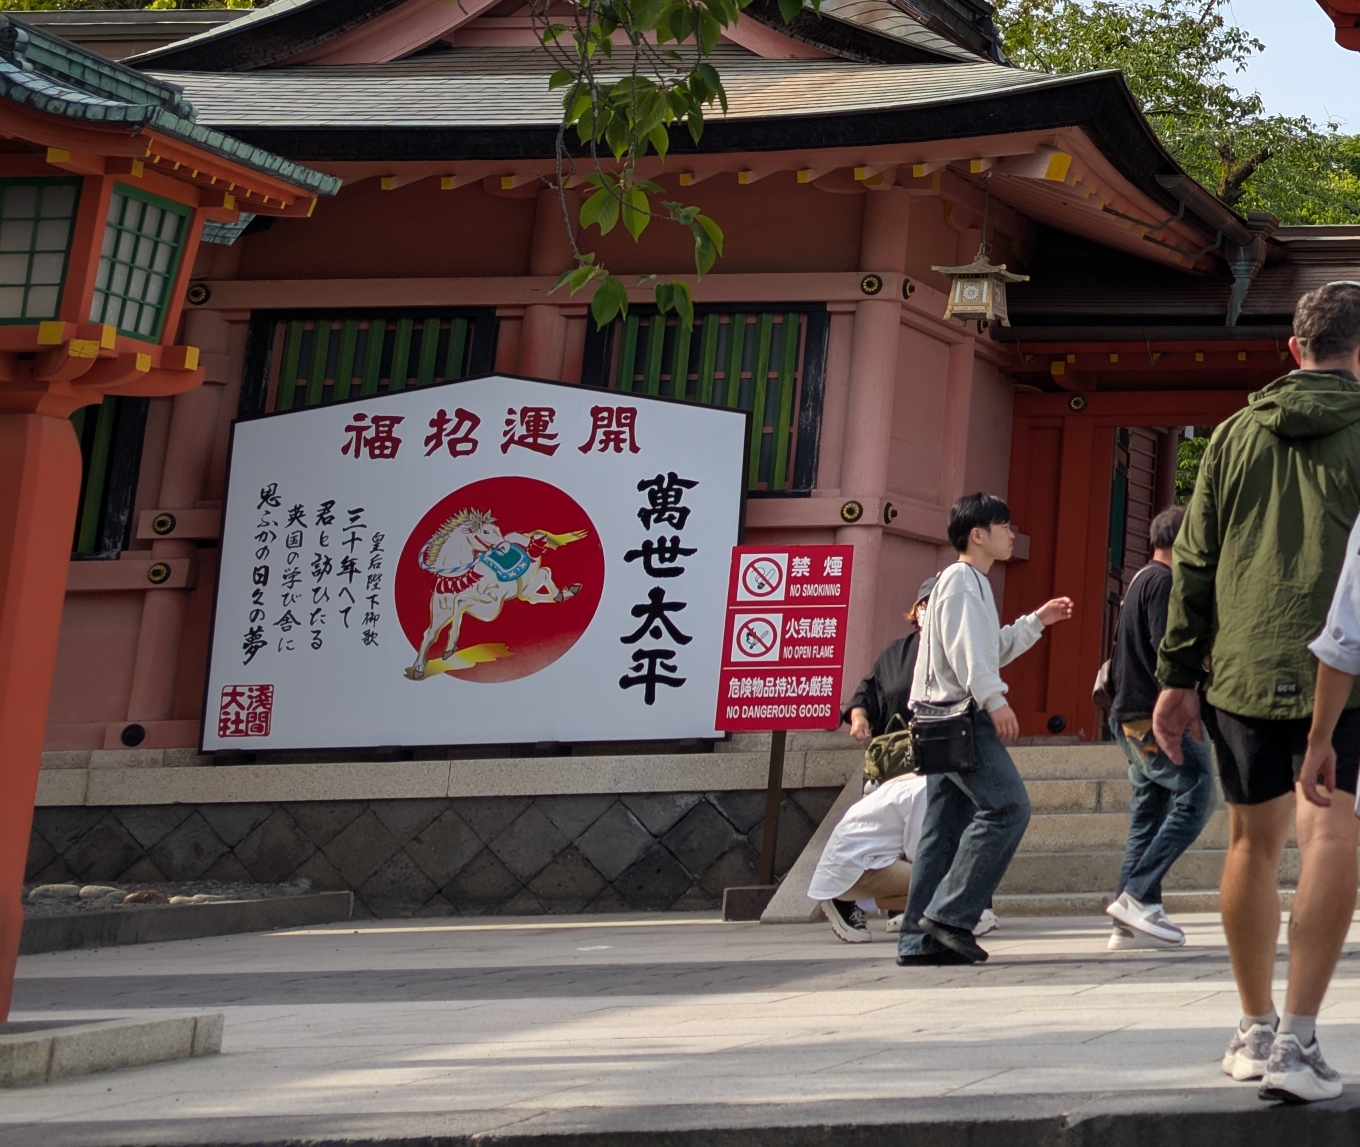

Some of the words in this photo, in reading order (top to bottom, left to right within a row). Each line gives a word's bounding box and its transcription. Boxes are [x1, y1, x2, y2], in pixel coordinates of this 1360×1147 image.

[242, 482, 282, 666] 思ふかの日々の夢
[272, 504, 308, 652] 英国の学び舎に
[310, 500, 336, 650] 君と訪ひたる
[336, 507, 367, 629] 三十年へて
[361, 531, 386, 647] 皇后陛下御歌
[619, 471, 700, 706] 萬世太平
[789, 585, 800, 597] NO
[801, 584, 841, 597] SMOKINNG
[791, 556, 844, 577] 禁煙
[783, 647, 793, 659] NO
[794, 646, 812, 659] OPEN
[812, 645, 835, 658] FLAME
[785, 617, 838, 639] 火気厳禁
[726, 705, 740, 719] NO
[742, 705, 797, 718] DANGEROUS
[799, 704, 831, 717] GOODS
[728, 676, 833, 698] 危険物品持込み厳禁
